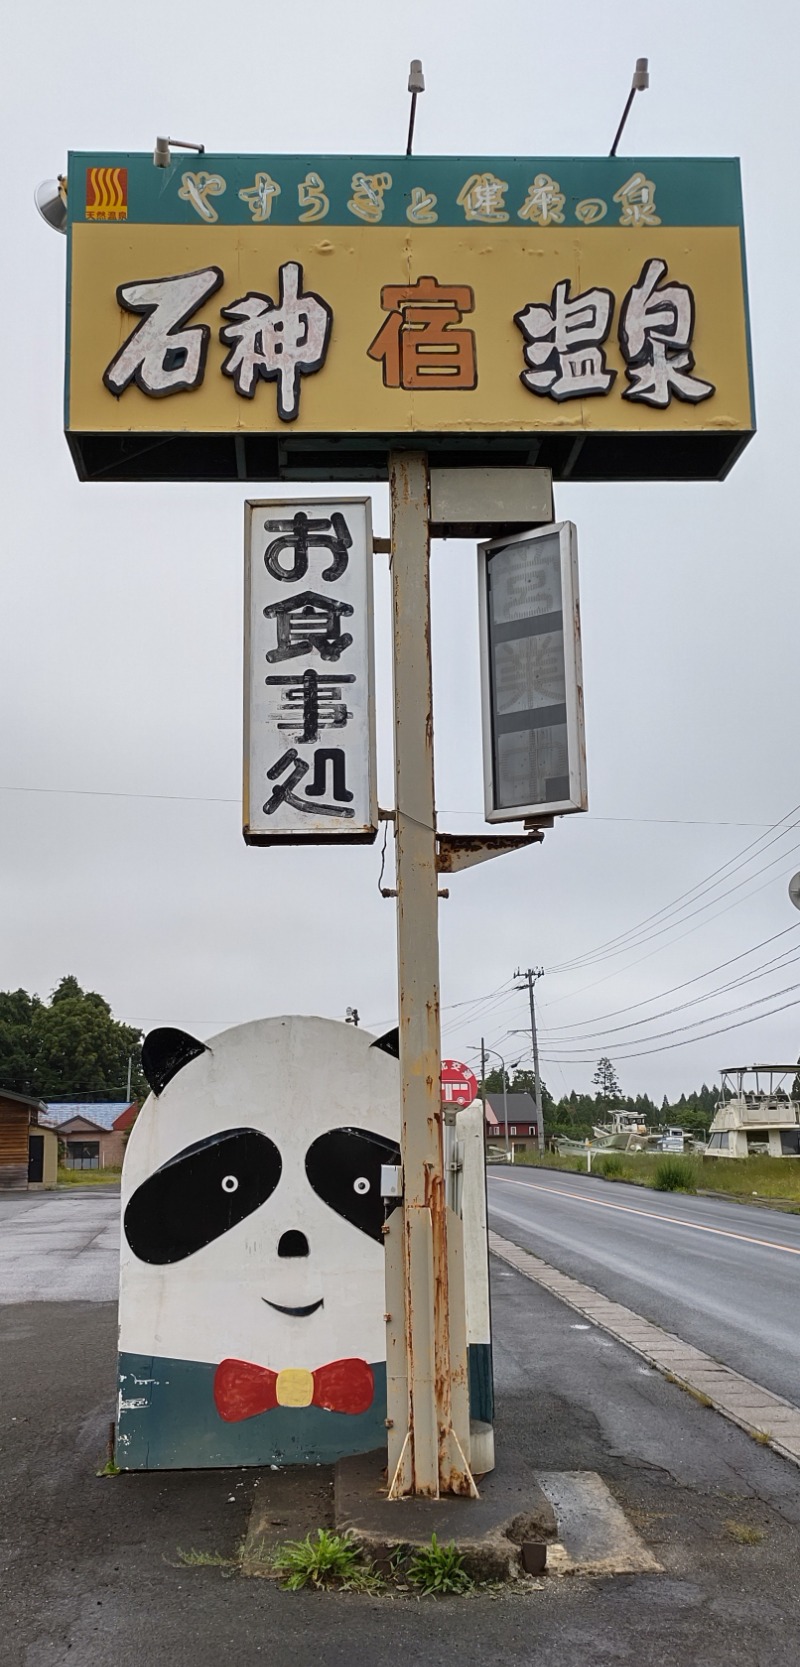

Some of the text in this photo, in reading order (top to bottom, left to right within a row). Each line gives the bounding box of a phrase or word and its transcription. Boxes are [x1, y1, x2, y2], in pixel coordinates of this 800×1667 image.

[85, 211, 127, 220] 天然温泉
[178, 171, 661, 227] やすらぎと健康の泉
[263, 511, 356, 818] お食事処
